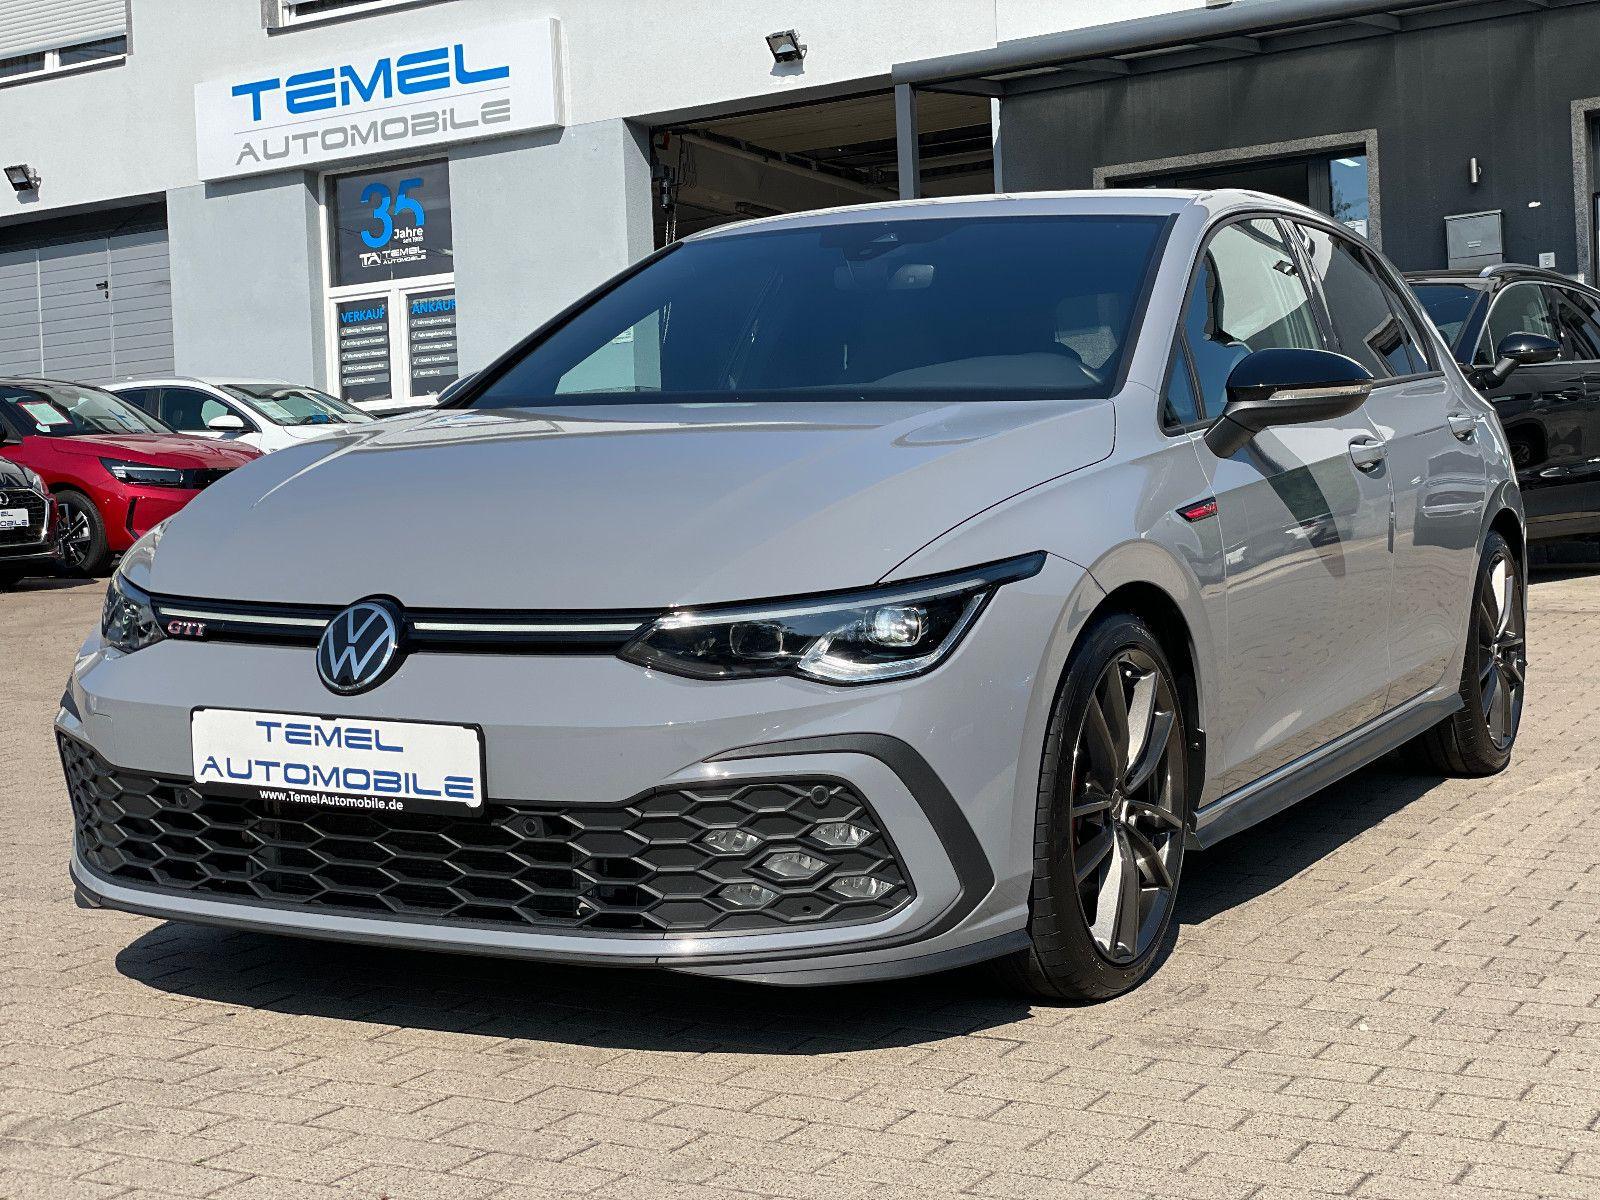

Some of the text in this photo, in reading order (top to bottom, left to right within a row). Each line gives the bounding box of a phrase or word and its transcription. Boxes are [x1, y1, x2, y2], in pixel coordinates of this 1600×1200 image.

[231, 43, 510, 122] TEMEL
[361, 178, 425, 248] 35
[394, 227, 424, 239] Jahre
[359, 246, 426, 268] TA TEMEL
[341, 307, 385, 323] VERKAUF
[167, 620, 207, 636] GTI
[256, 721, 404, 753] TEMEL
[200, 756, 475, 799] AUTOMOBILE
[259, 788, 404, 811] www.TemelAutomobile.de
